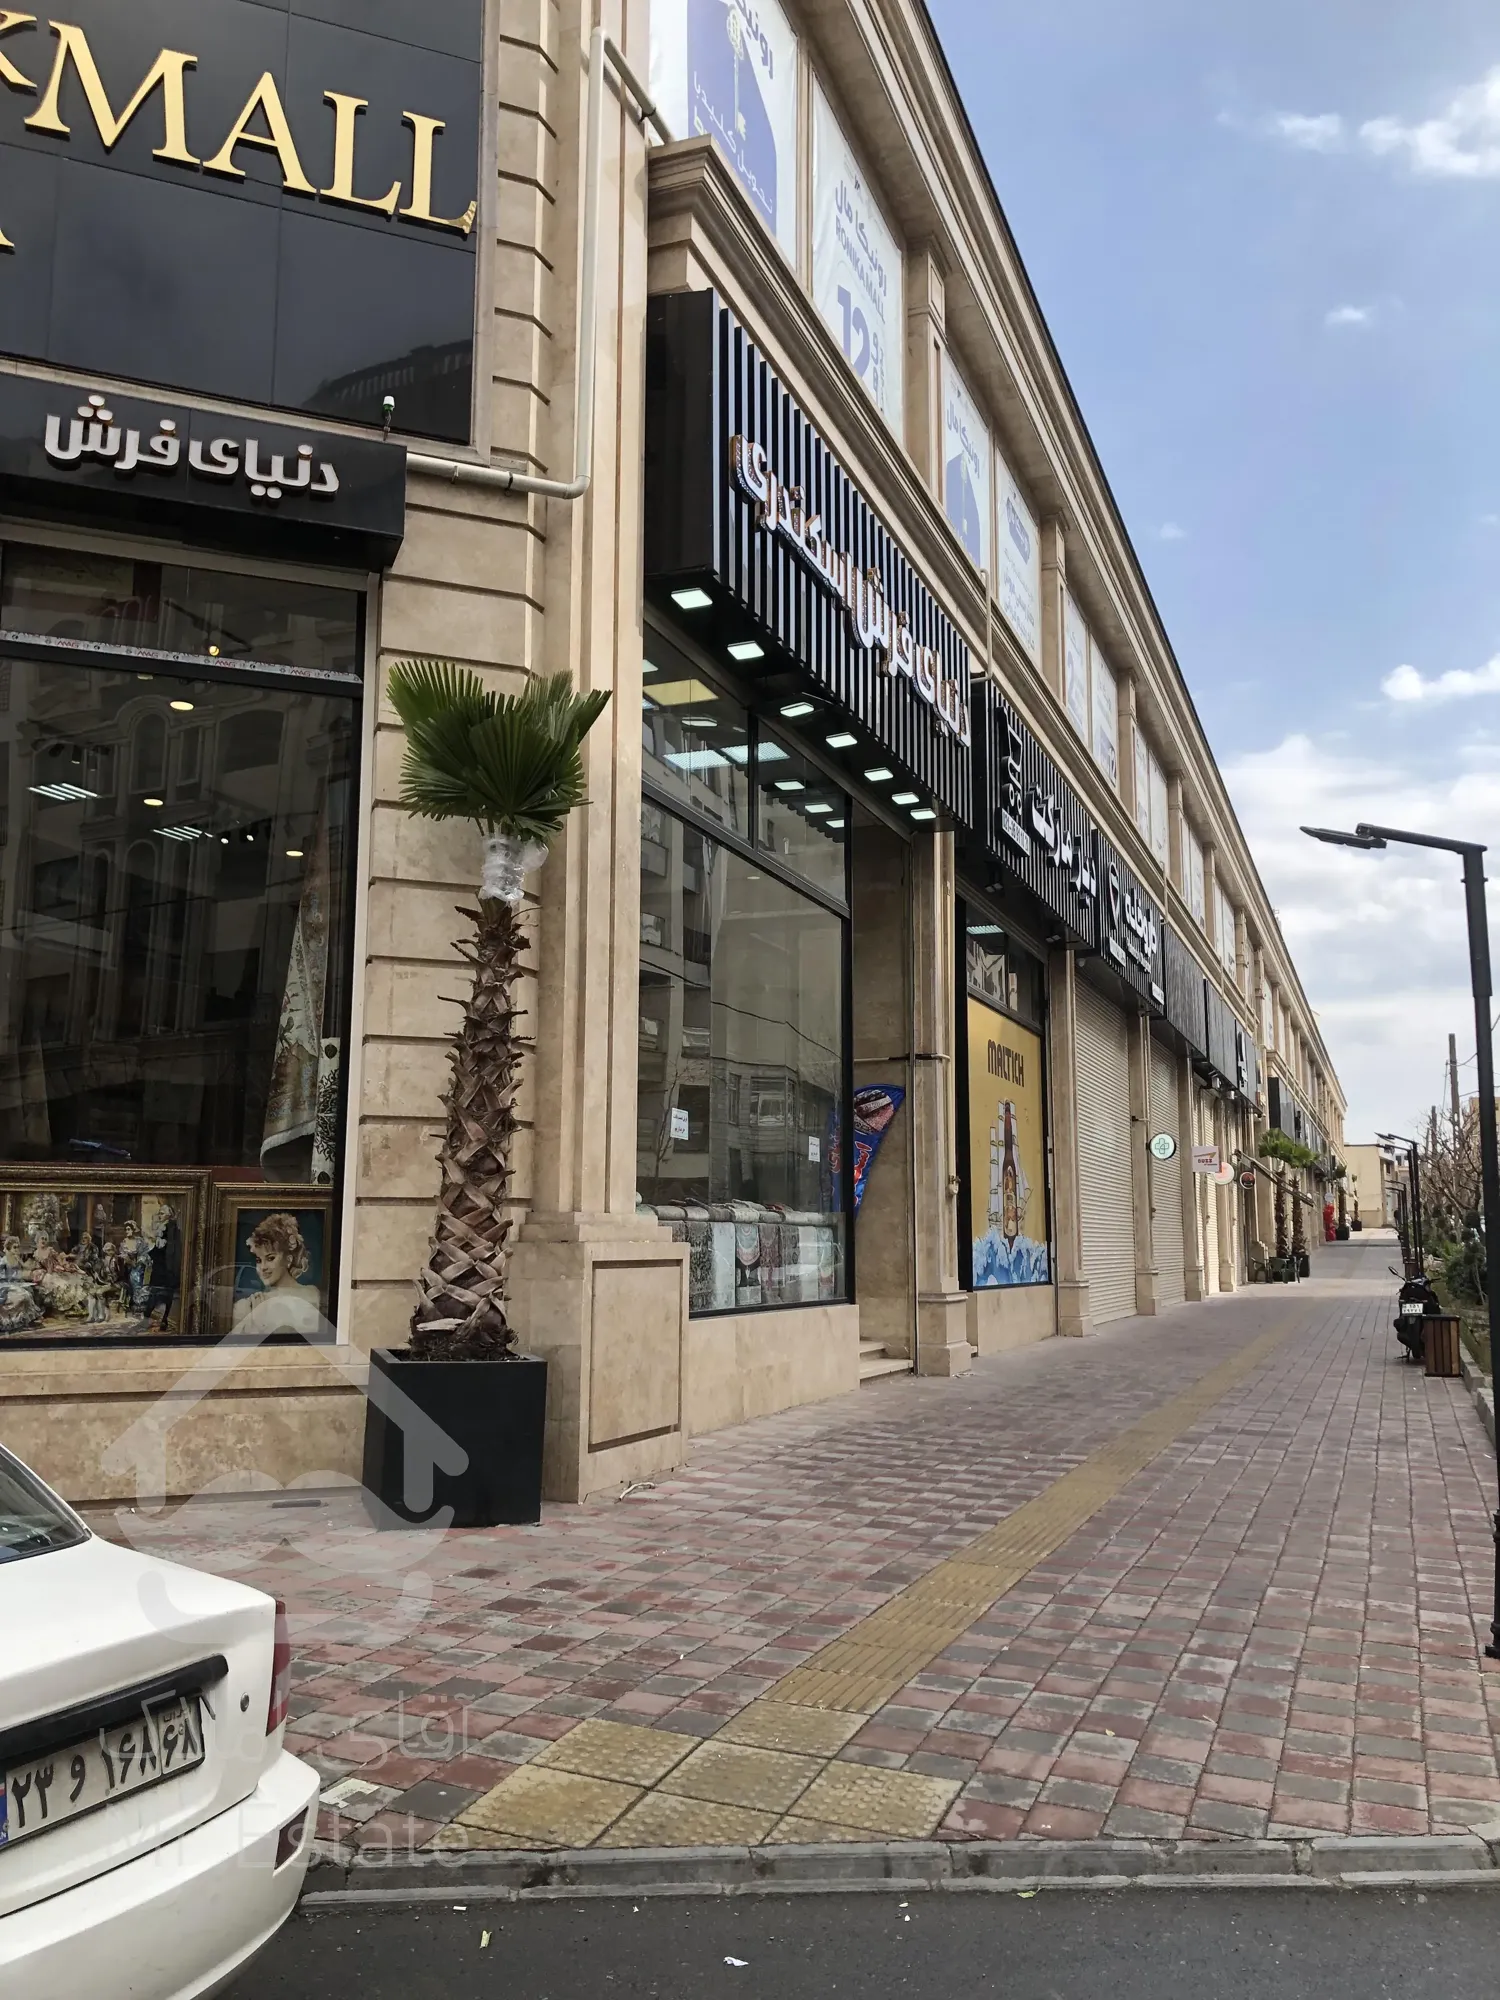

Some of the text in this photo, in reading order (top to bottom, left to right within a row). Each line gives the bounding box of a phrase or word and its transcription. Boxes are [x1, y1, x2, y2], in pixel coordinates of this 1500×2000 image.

[736, 148, 774, 214] تحویل
[835, 179, 888, 297] رونیکا مال
[44, 395, 339, 500] دنیای فرش
[729, 434, 972, 748] دنیای فرش اسکندری
[1032, 784, 1074, 869] مارکت
[987, 1039, 1025, 1088] MALTICH
[11, 1717, 198, 1828] ۲۳ و ۱۶۸ ۶۸
